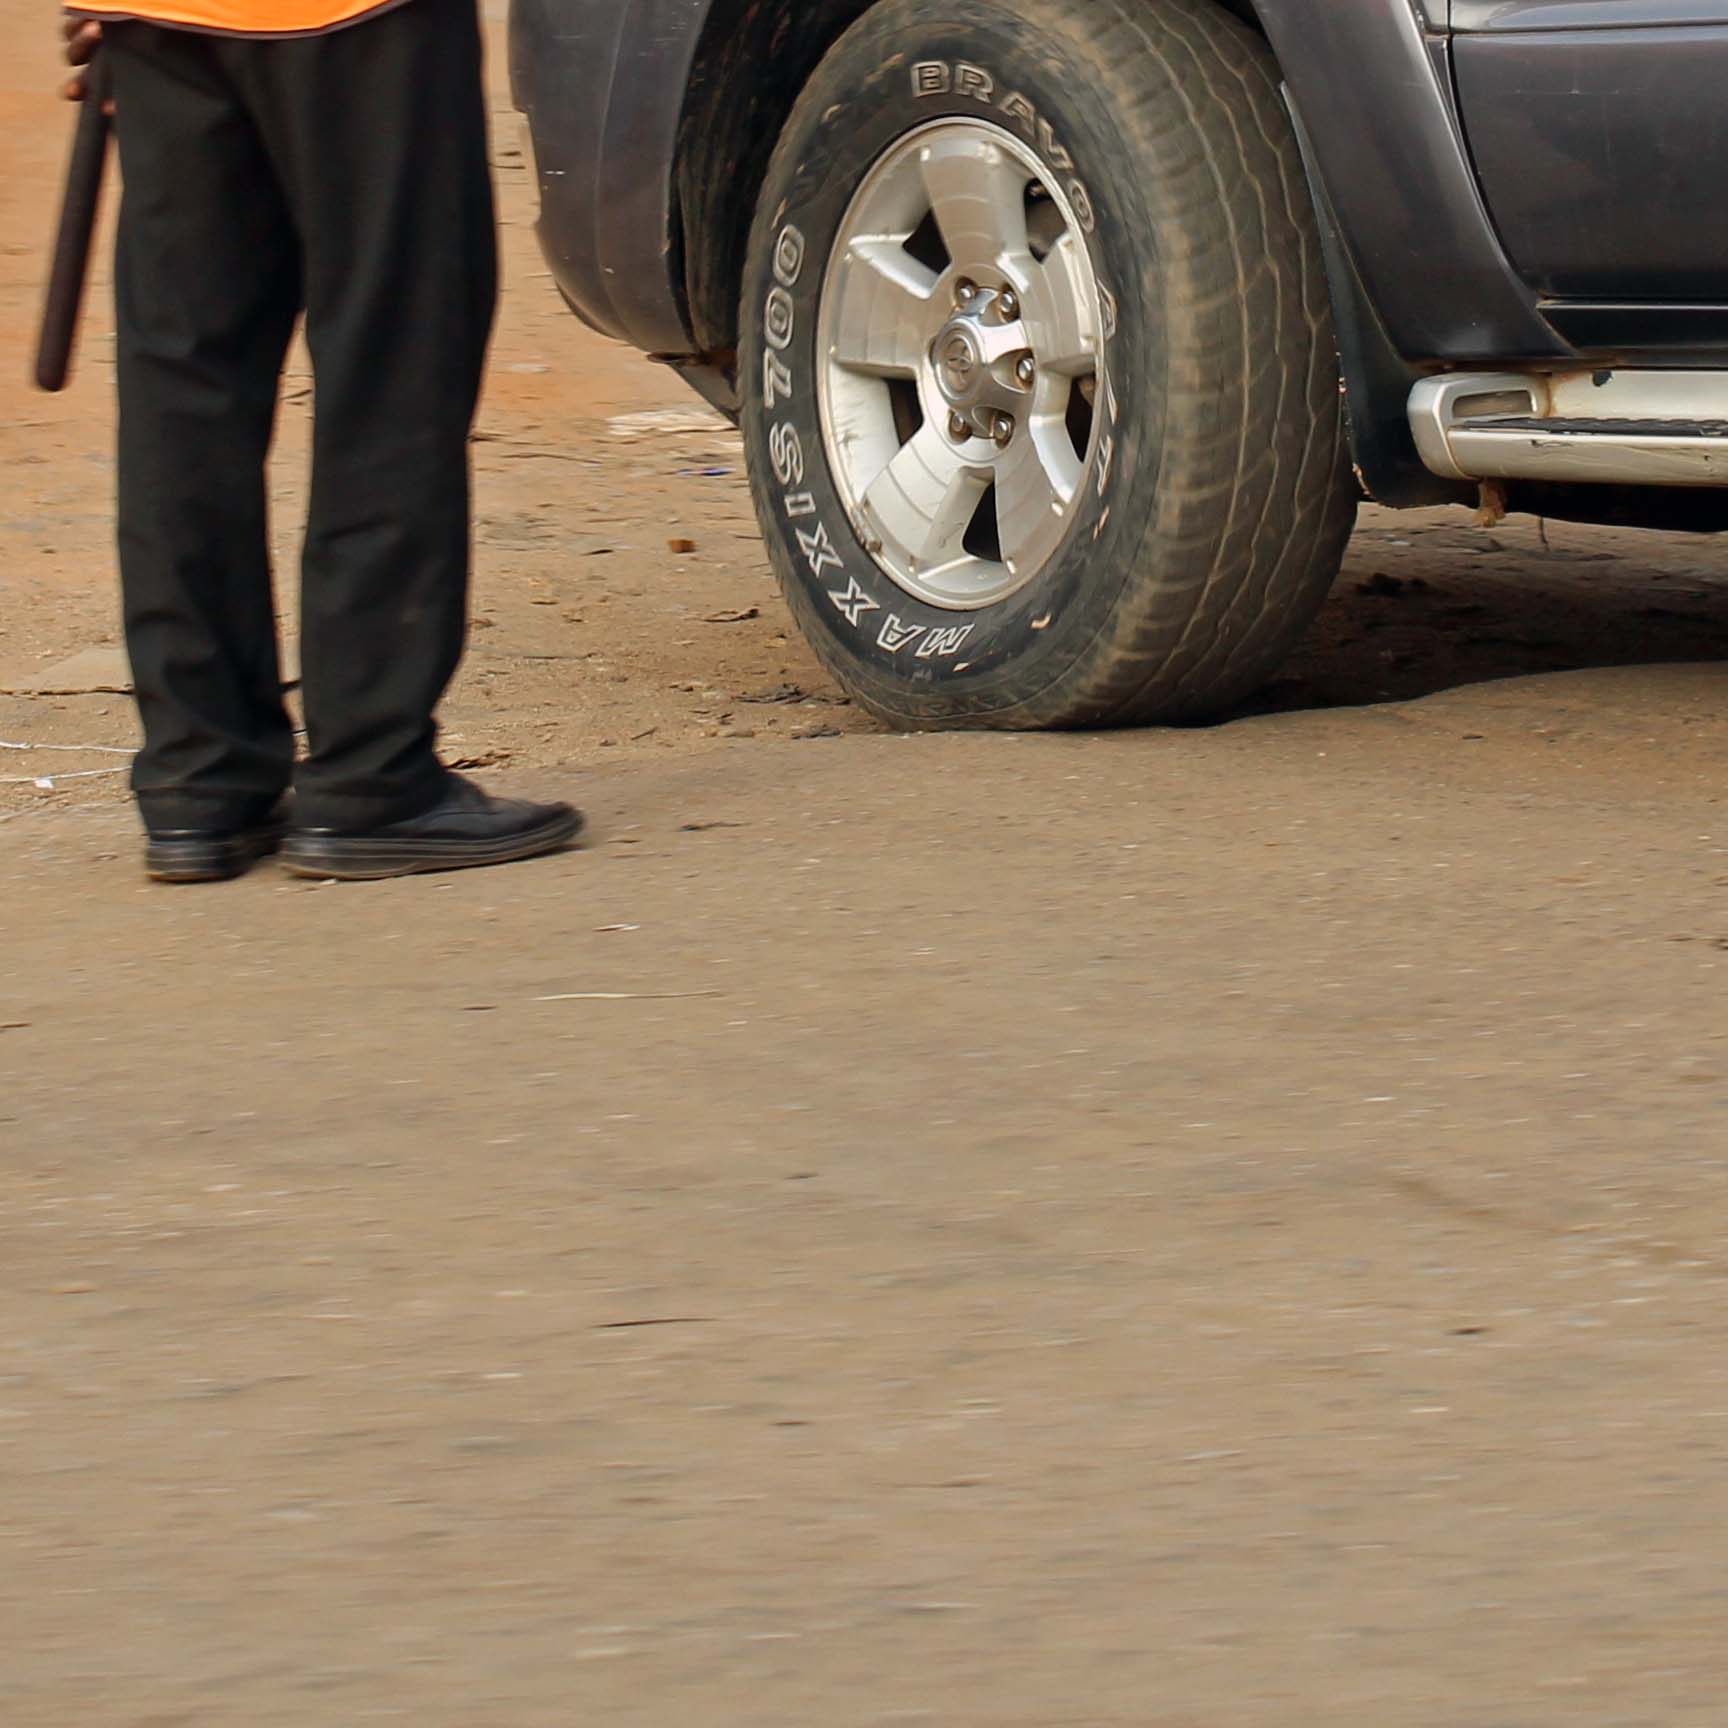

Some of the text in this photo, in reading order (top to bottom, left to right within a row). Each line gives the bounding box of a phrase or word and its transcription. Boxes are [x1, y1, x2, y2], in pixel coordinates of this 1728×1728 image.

[910, 60, 1095, 233] BRAVO
[763, 224, 976, 659] MAXXIS 700
